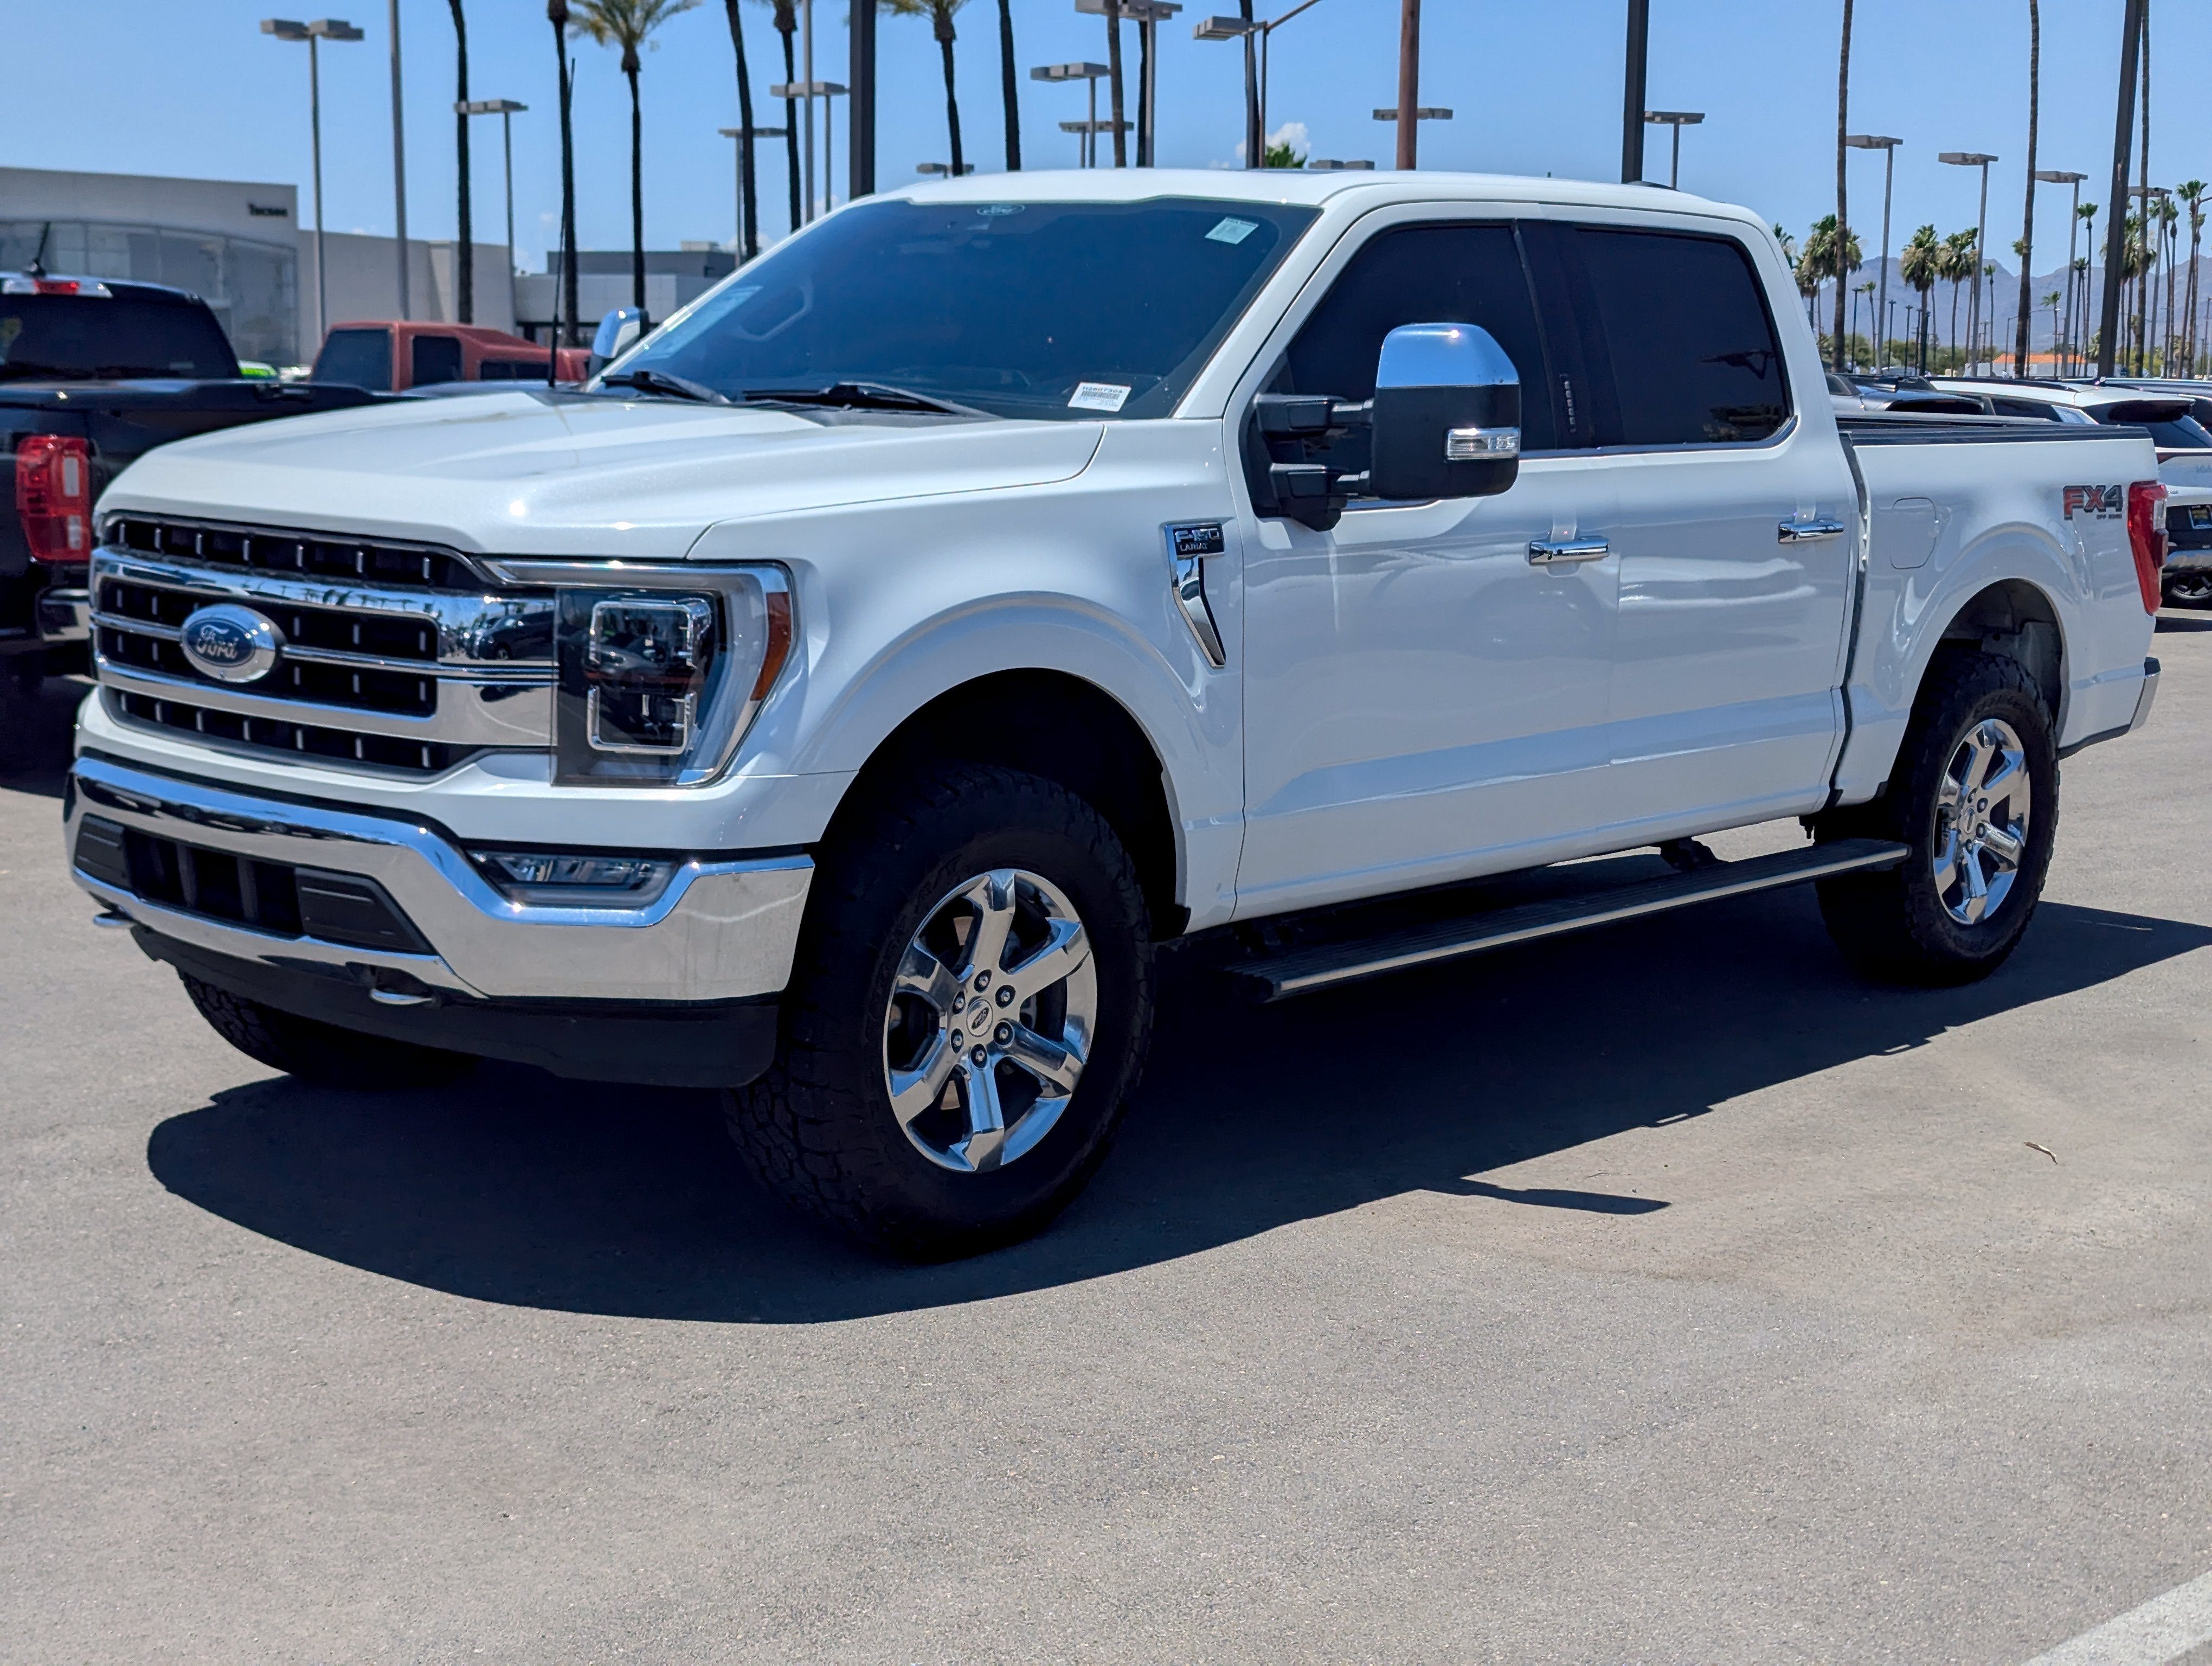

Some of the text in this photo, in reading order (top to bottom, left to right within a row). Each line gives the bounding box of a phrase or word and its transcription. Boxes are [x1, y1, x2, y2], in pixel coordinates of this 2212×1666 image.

[2062, 484, 2124, 521] FX4
[1174, 528, 1222, 543] F-150
[1180, 542, 1209, 552] LARIAT
[195, 624, 240, 660] Ford
